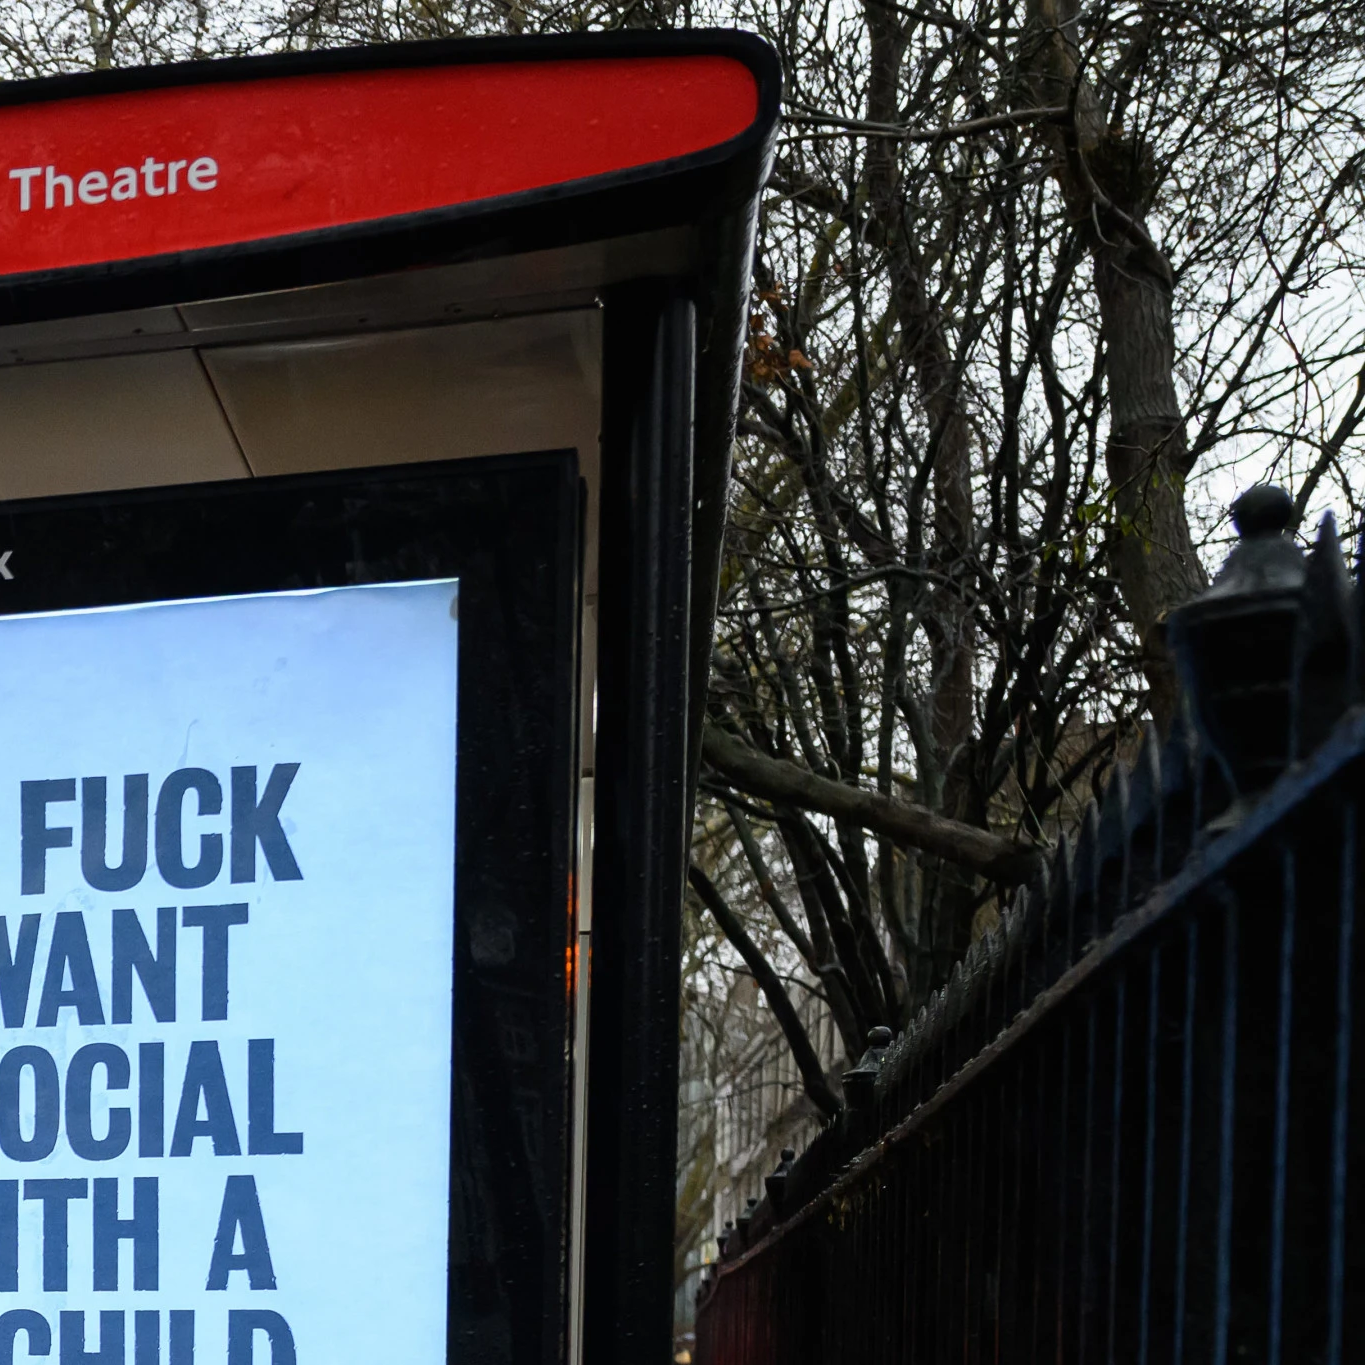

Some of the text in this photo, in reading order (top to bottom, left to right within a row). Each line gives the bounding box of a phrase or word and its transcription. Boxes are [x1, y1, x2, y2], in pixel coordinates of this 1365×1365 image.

[9, 155, 219, 212] Theatre
[19, 762, 304, 896] FUCK
[204, 1174, 278, 1292] A
